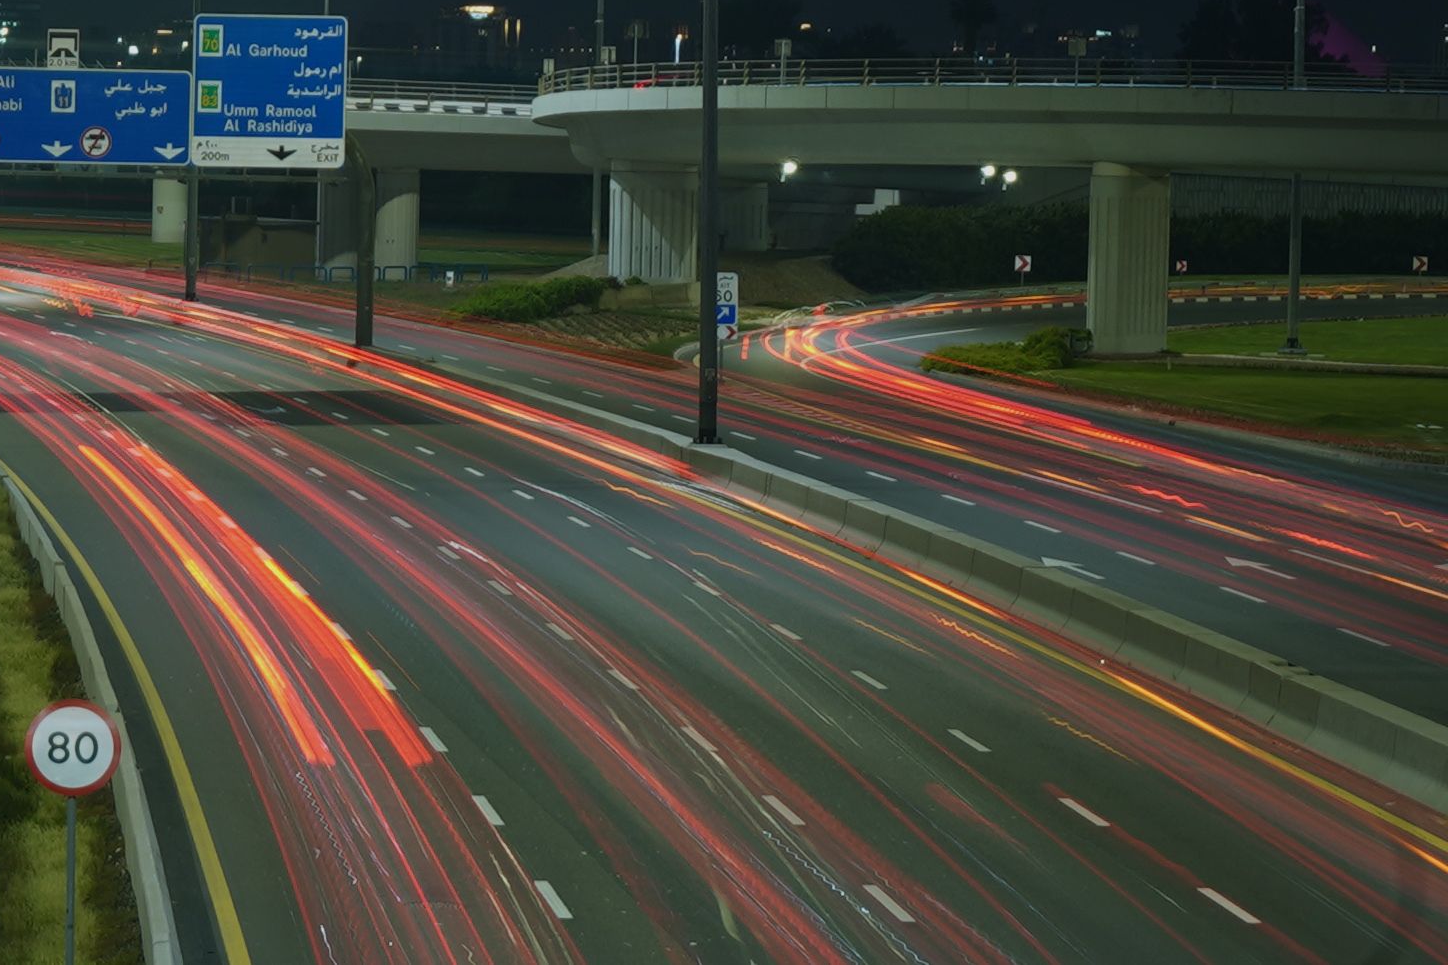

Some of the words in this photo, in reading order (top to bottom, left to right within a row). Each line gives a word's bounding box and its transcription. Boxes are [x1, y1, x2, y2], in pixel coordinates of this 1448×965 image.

[294, 25, 342, 40] القرهود
[226, 43, 241, 57] Al
[249, 44, 308, 58] Garhoud
[294, 62, 327, 78] رمول
[104, 79, 133, 97] علي
[138, 79, 167, 94] جبل
[287, 84, 342, 100] الراشدية
[115, 101, 146, 120] ظبي
[224, 104, 259, 117] Umm
[265, 104, 317, 118] Ramool
[224, 119, 239, 132] Al
[201, 151, 230, 161] 200m
[317, 153, 339, 162] EXIT
[47, 731, 99, 764] 80
